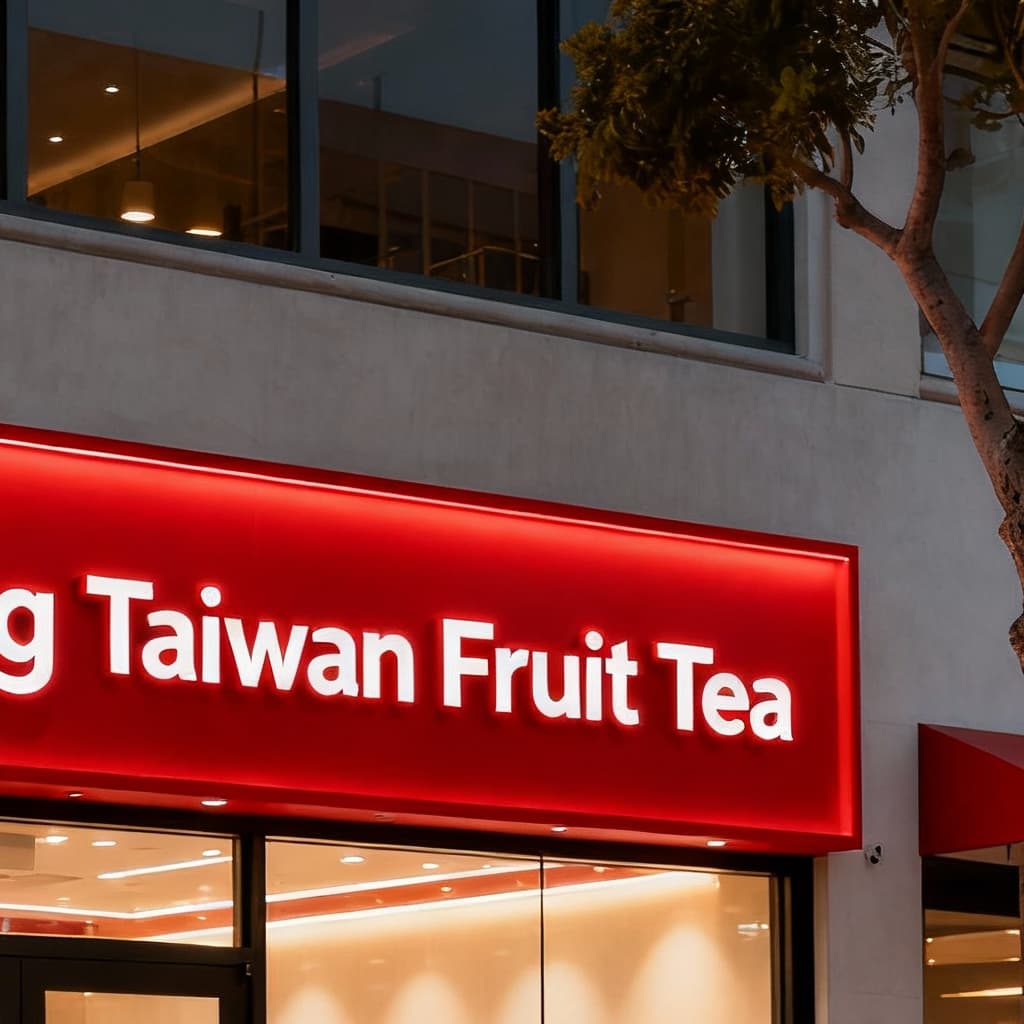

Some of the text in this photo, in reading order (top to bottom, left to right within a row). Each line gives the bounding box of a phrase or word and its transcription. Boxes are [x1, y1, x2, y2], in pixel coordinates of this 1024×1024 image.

[85, 574, 414, 704] Taiwan
[442, 617, 640, 726] Fruit
[656, 641, 794, 742] Tea
